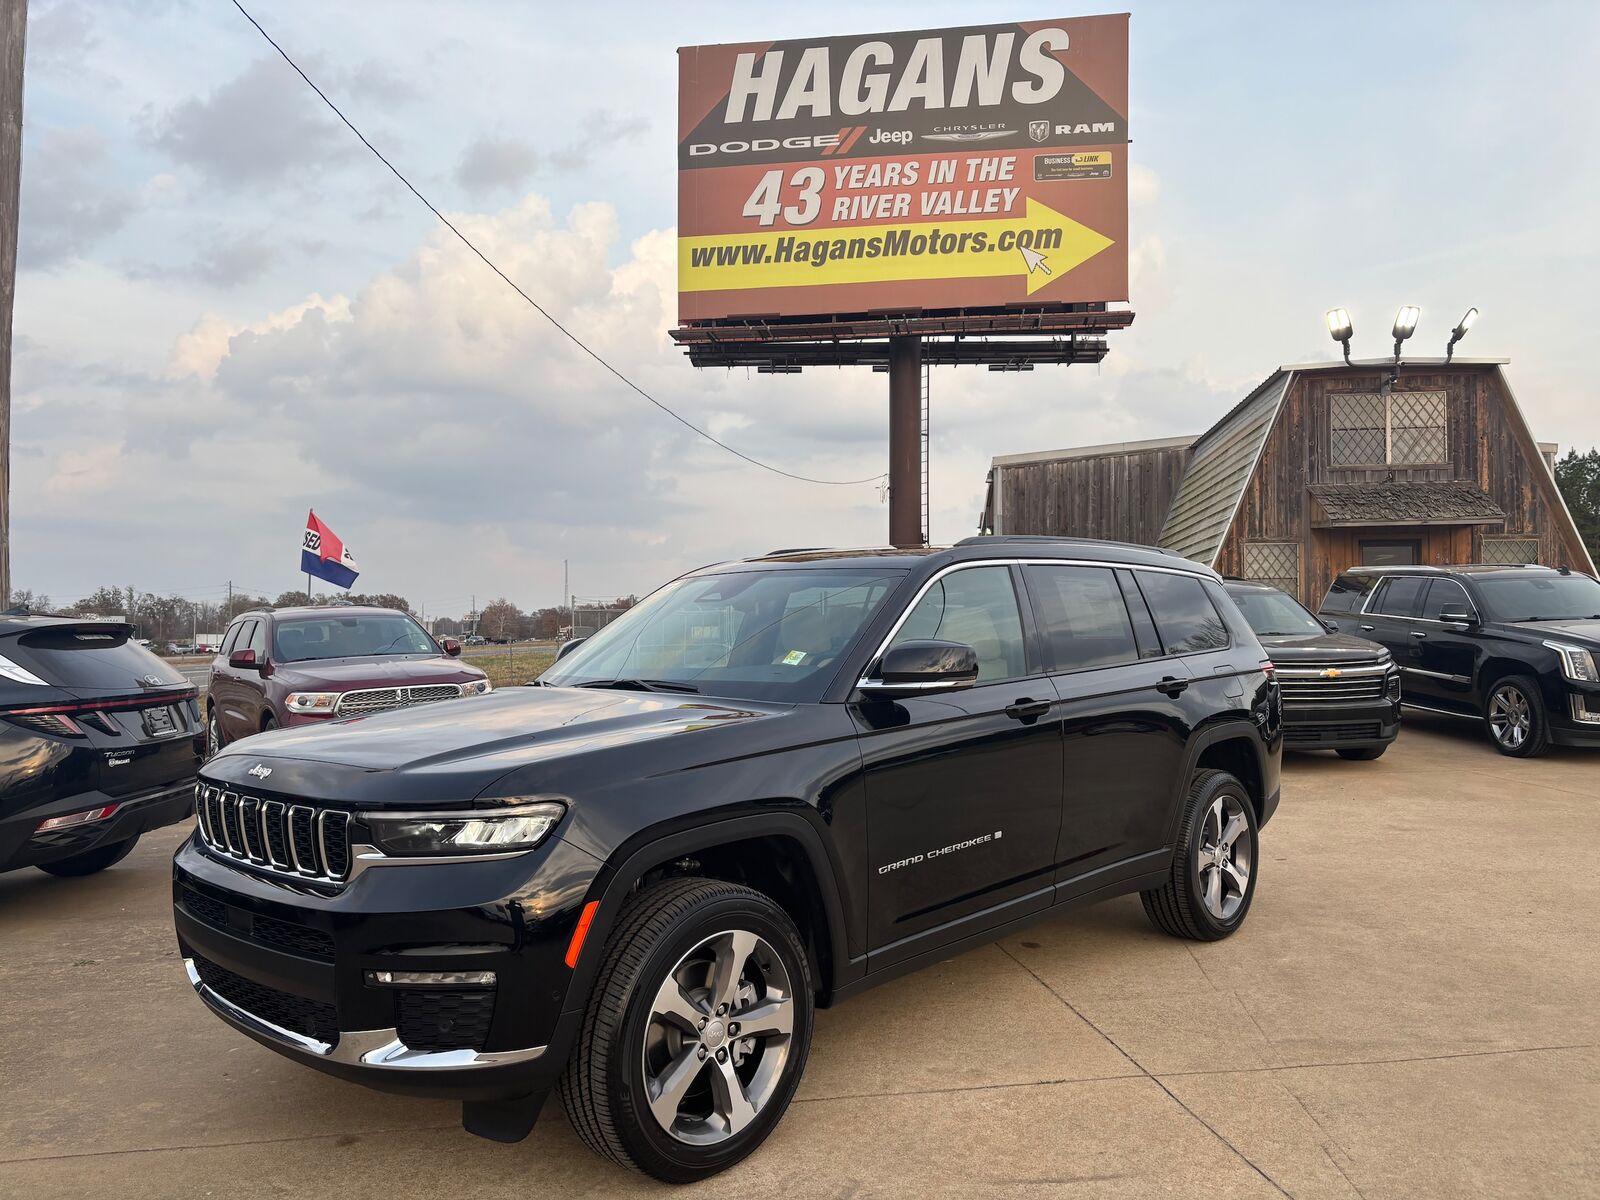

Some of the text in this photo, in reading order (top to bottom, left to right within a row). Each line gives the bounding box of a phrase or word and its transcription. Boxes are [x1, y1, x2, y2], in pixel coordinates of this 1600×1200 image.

[724, 28, 1069, 123] HAGANS
[869, 128, 913, 145] Jeep
[933, 123, 1006, 132] CHRYSLER
[1055, 122, 1115, 135] RAM
[689, 134, 840, 156] DODGE
[834, 156, 1017, 190] YEARS IN THE
[1044, 155, 1100, 165] BUSINESS LINK
[742, 166, 827, 226] 43
[832, 187, 1021, 221] RIVER VALLEY
[691, 228, 1063, 268] www.HagansMotors.com
[248, 763, 273, 780] Jeep
[878, 833, 992, 875] GRAND CHEROKEE
